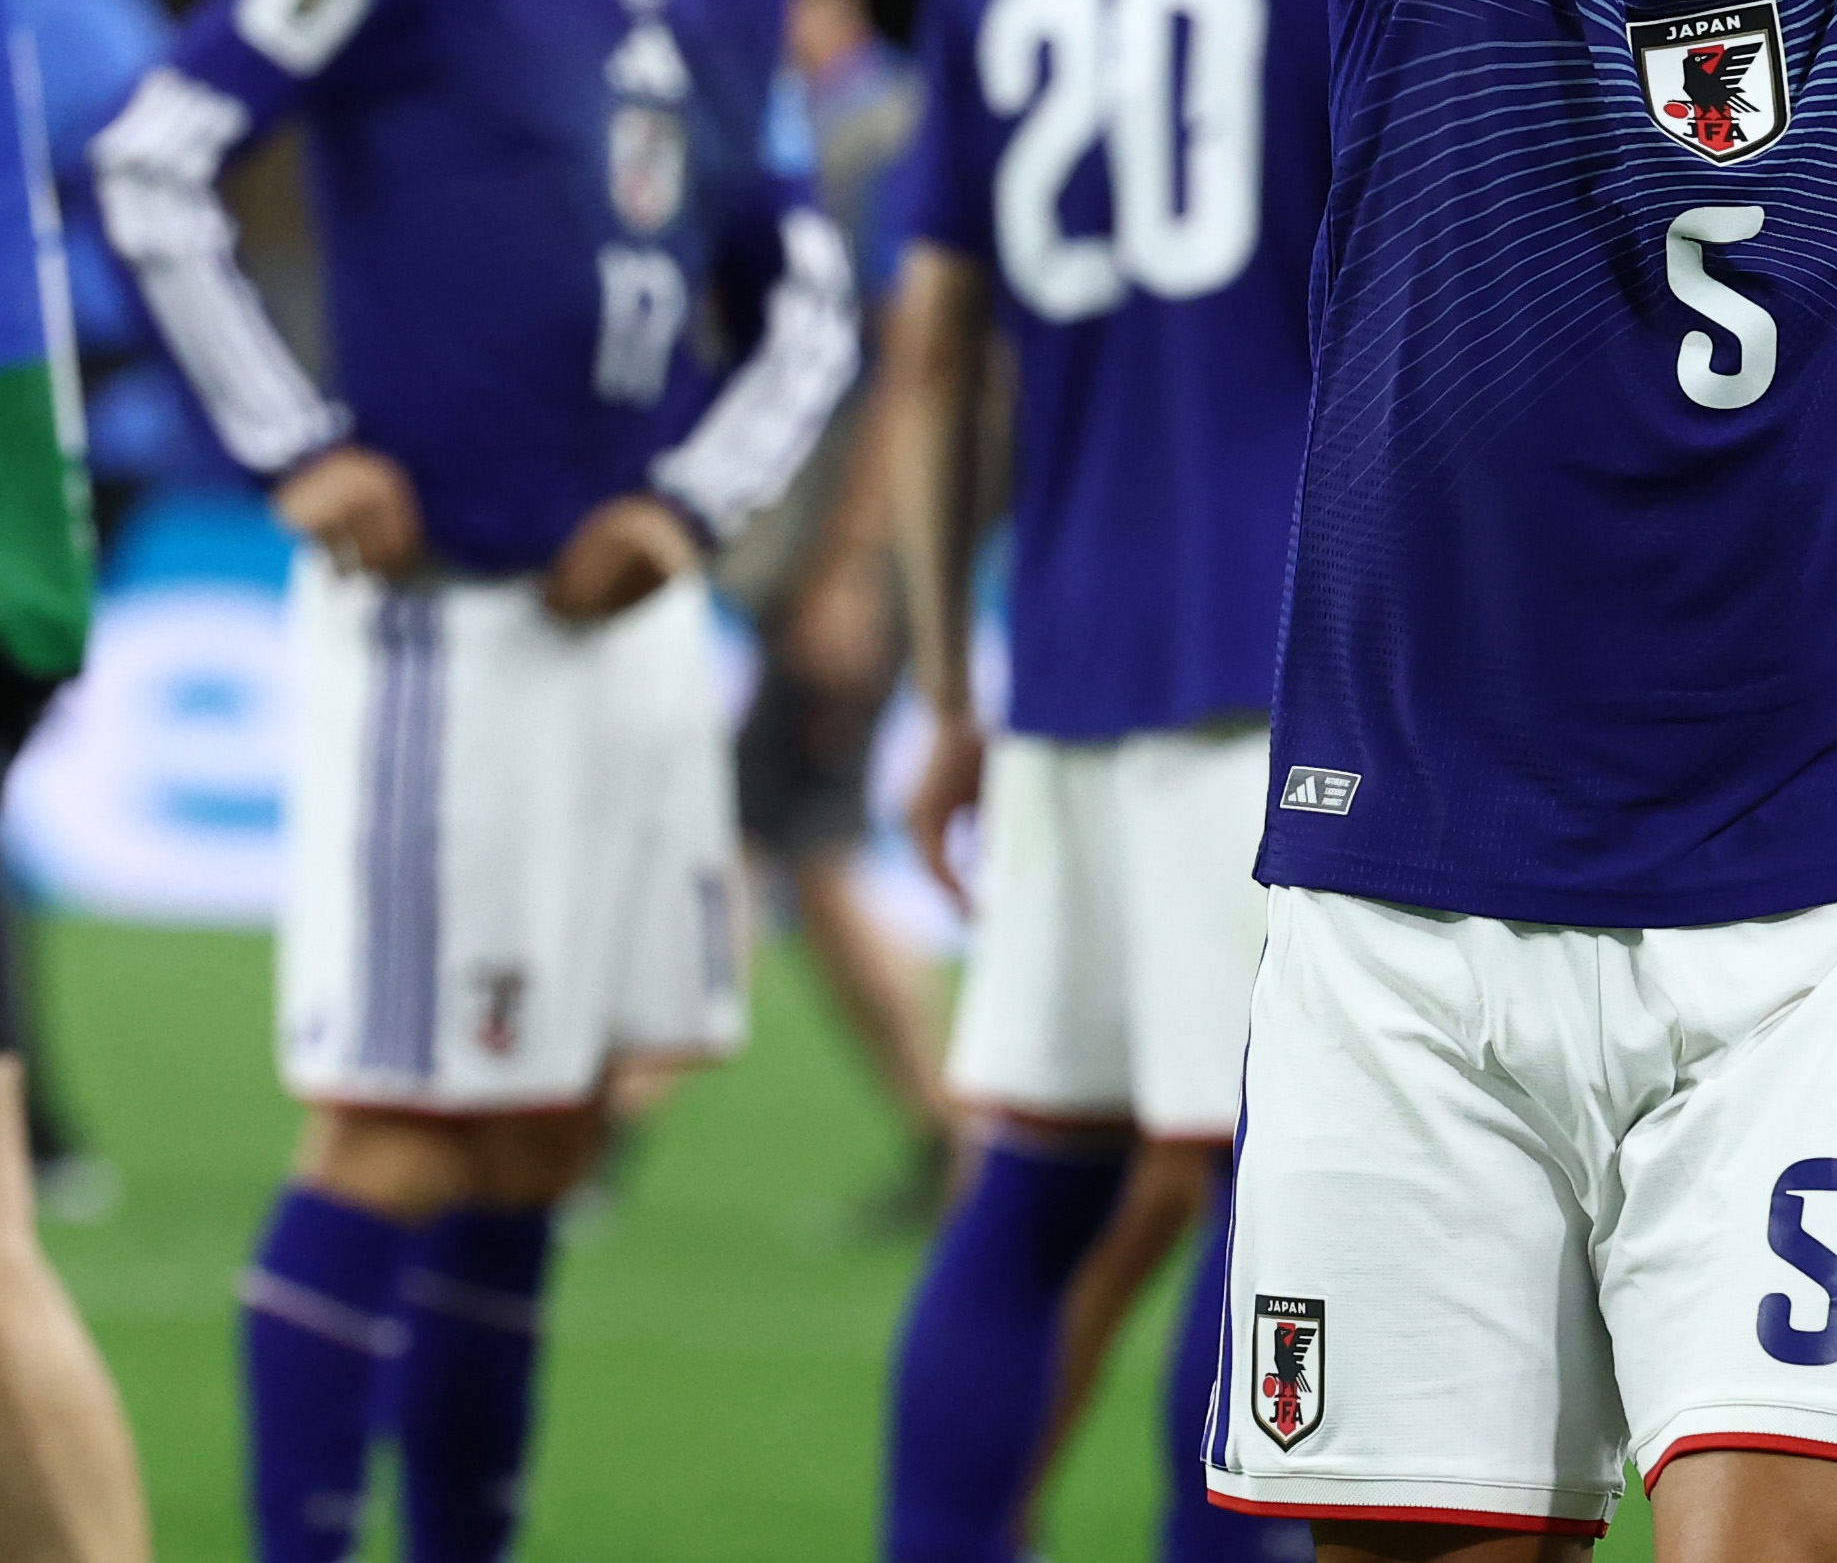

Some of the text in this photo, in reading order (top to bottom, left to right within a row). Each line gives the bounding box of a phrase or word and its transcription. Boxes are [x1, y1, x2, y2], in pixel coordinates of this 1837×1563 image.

[1666, 15, 1741, 40] JAPAN
[1683, 122, 1748, 142] JFA
[1666, 205, 1777, 410] 5
[1267, 1299, 1307, 1314] JAPAN
[1269, 1400, 1304, 1425] JFA
